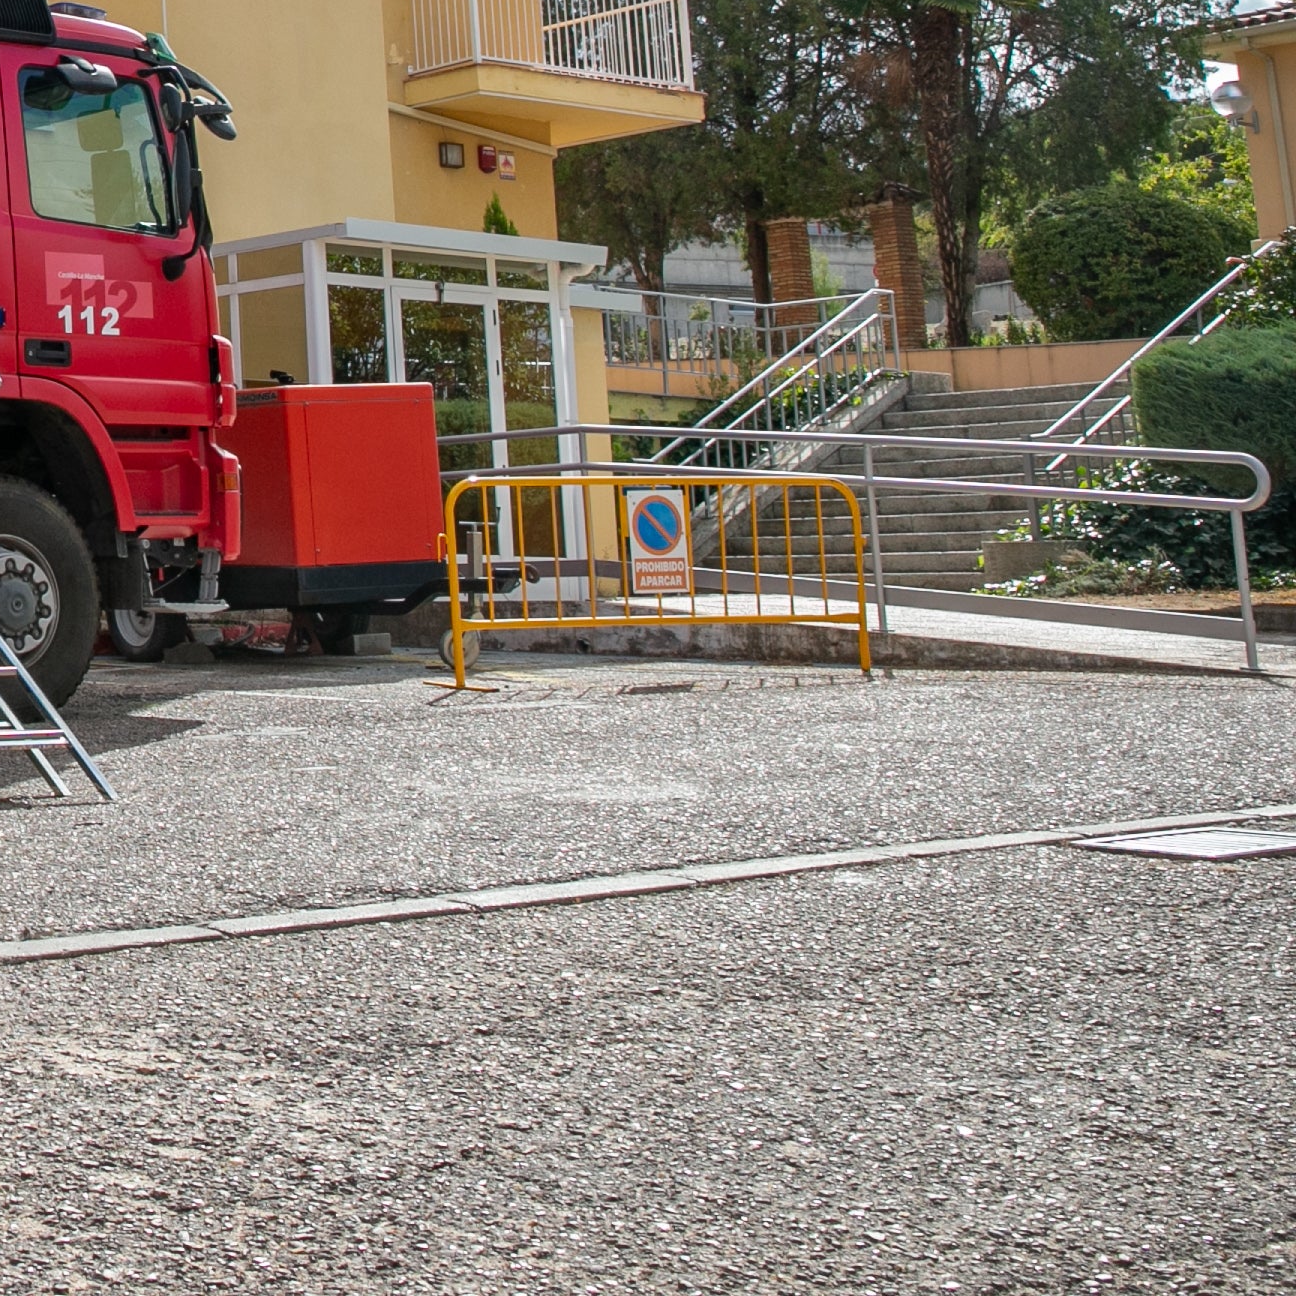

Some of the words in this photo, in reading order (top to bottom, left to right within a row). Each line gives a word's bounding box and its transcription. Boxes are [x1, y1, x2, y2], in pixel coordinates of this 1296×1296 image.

[57, 304, 121, 336] 112
[635, 560, 685, 573] PROHIBIDO
[639, 575, 683, 587] APARCAR
